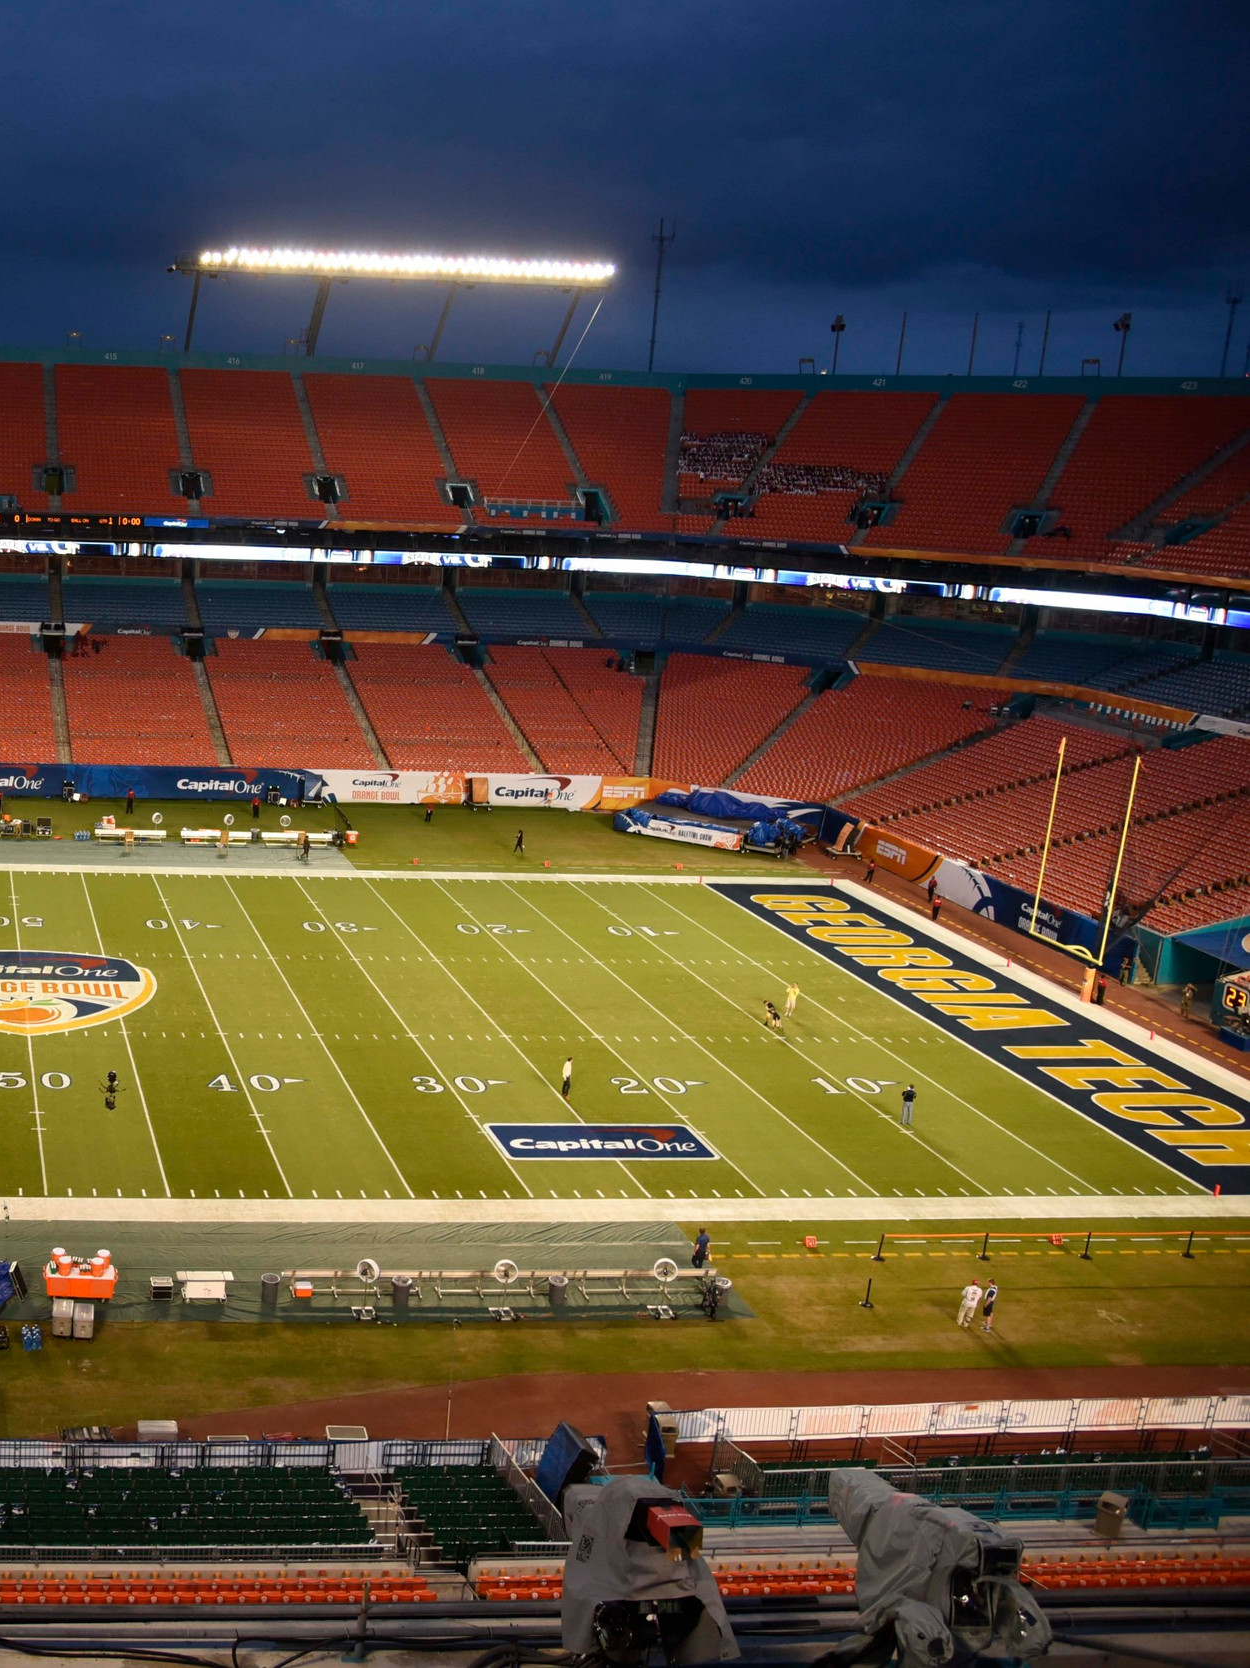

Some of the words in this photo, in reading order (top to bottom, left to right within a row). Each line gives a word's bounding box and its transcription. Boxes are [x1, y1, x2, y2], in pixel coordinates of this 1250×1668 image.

[104, 352, 117, 360] 415
[227, 357, 240, 365] 416
[351, 362, 365, 370] 417
[472, 366, 485, 375] 418
[599, 373, 612, 381] 419
[739, 376, 753, 385] 420
[872, 378, 886, 387] 421
[1012, 379, 1028, 389] 422
[1180, 381, 1197, 390] 423
[14, 514, 20, 523] 0
[122, 517, 141, 525] 0:00
[352, 790, 379, 800] ORANGE
[380, 791, 401, 801] BOWL
[602, 785, 647, 800] ESPN
[876, 839, 907, 865] ESPN
[144, 917, 200, 932] 40
[301, 920, 359, 934] 30
[455, 923, 514, 936] 20
[605, 924, 665, 938] 10
[749, 893, 1071, 1031] GEORGIA
[41, 981, 128, 1001] BOWL
[1225, 986, 1247, 1008] 23
[207, 1072, 283, 1093] 40
[411, 1074, 489, 1095] 30
[610, 1076, 688, 1095] 20
[811, 1075, 885, 1096] 10
[1002, 1038, 1250, 1169] TECH
[806, 1237, 816, 1247] 20
